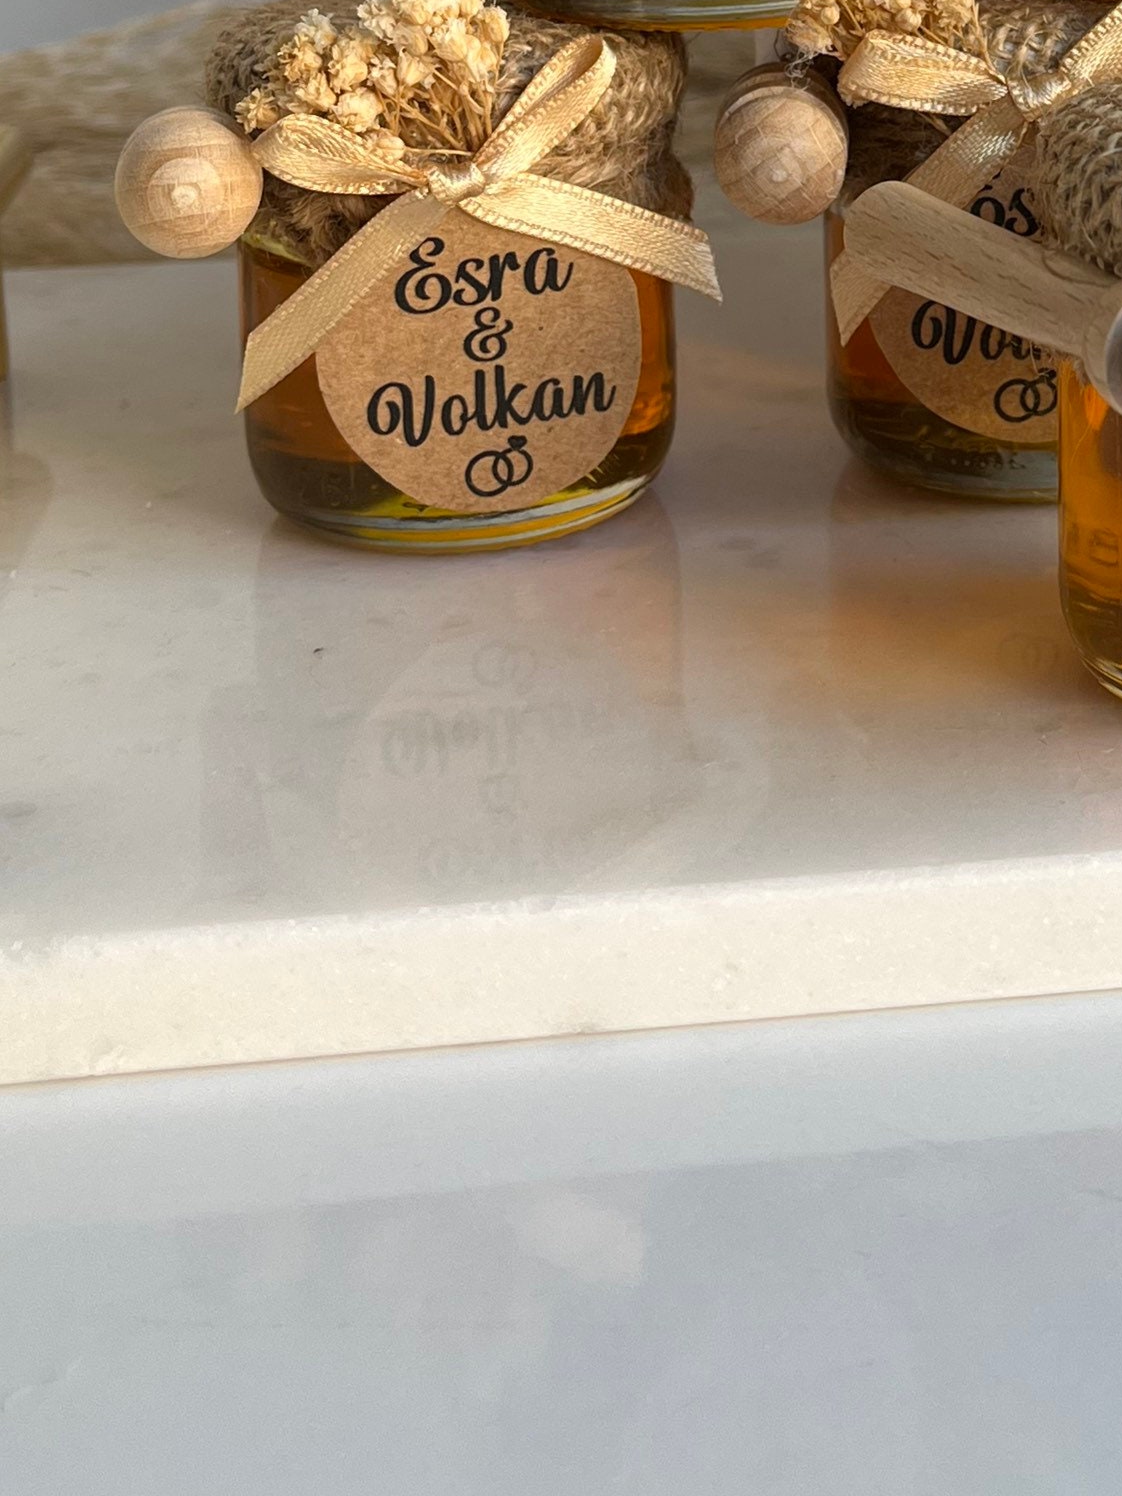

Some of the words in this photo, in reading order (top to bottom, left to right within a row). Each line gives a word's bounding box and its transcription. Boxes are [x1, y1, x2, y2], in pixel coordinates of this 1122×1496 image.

[395, 237, 574, 314] Esra
[463, 306, 514, 362] &
[367, 364, 617, 447] Volkan
